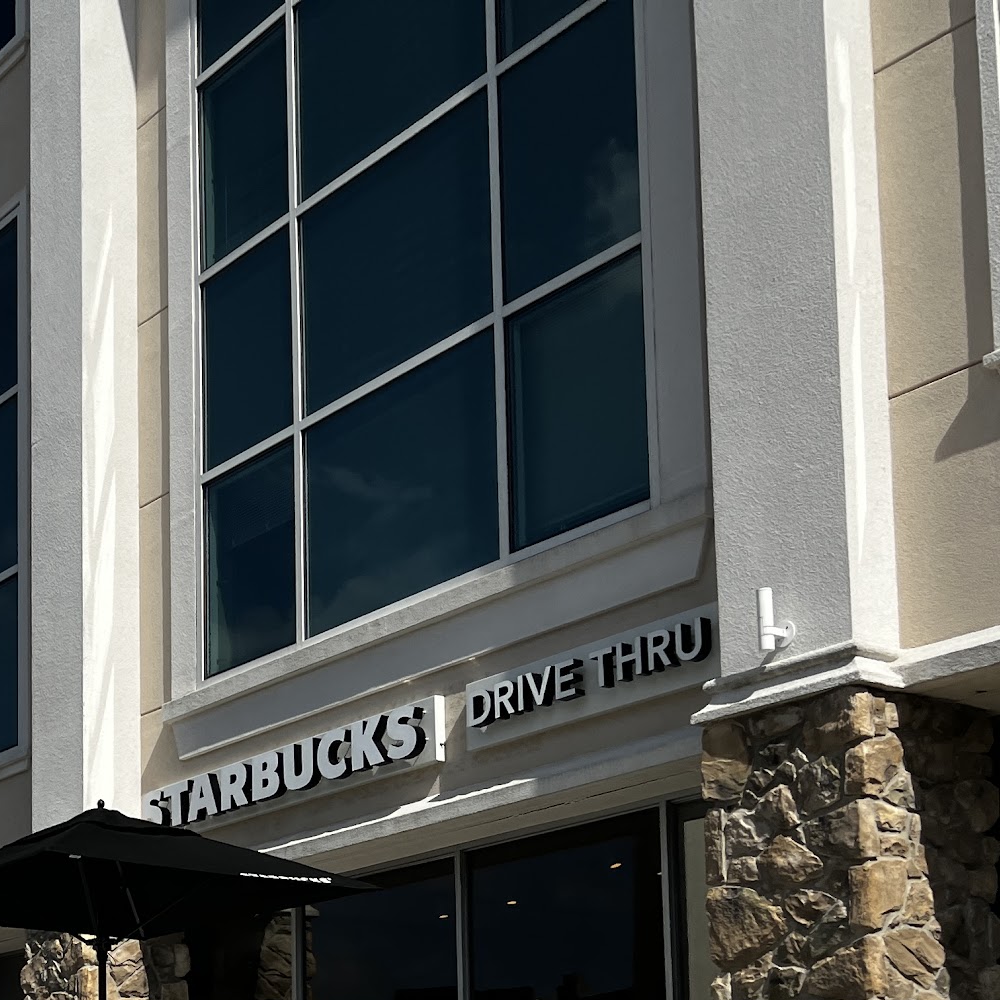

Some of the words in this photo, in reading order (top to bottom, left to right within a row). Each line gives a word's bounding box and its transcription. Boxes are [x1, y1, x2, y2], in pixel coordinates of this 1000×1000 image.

[466, 657, 586, 729] DRIVE
[588, 616, 712, 689] THRU
[142, 705, 428, 827] STARBUCKS
